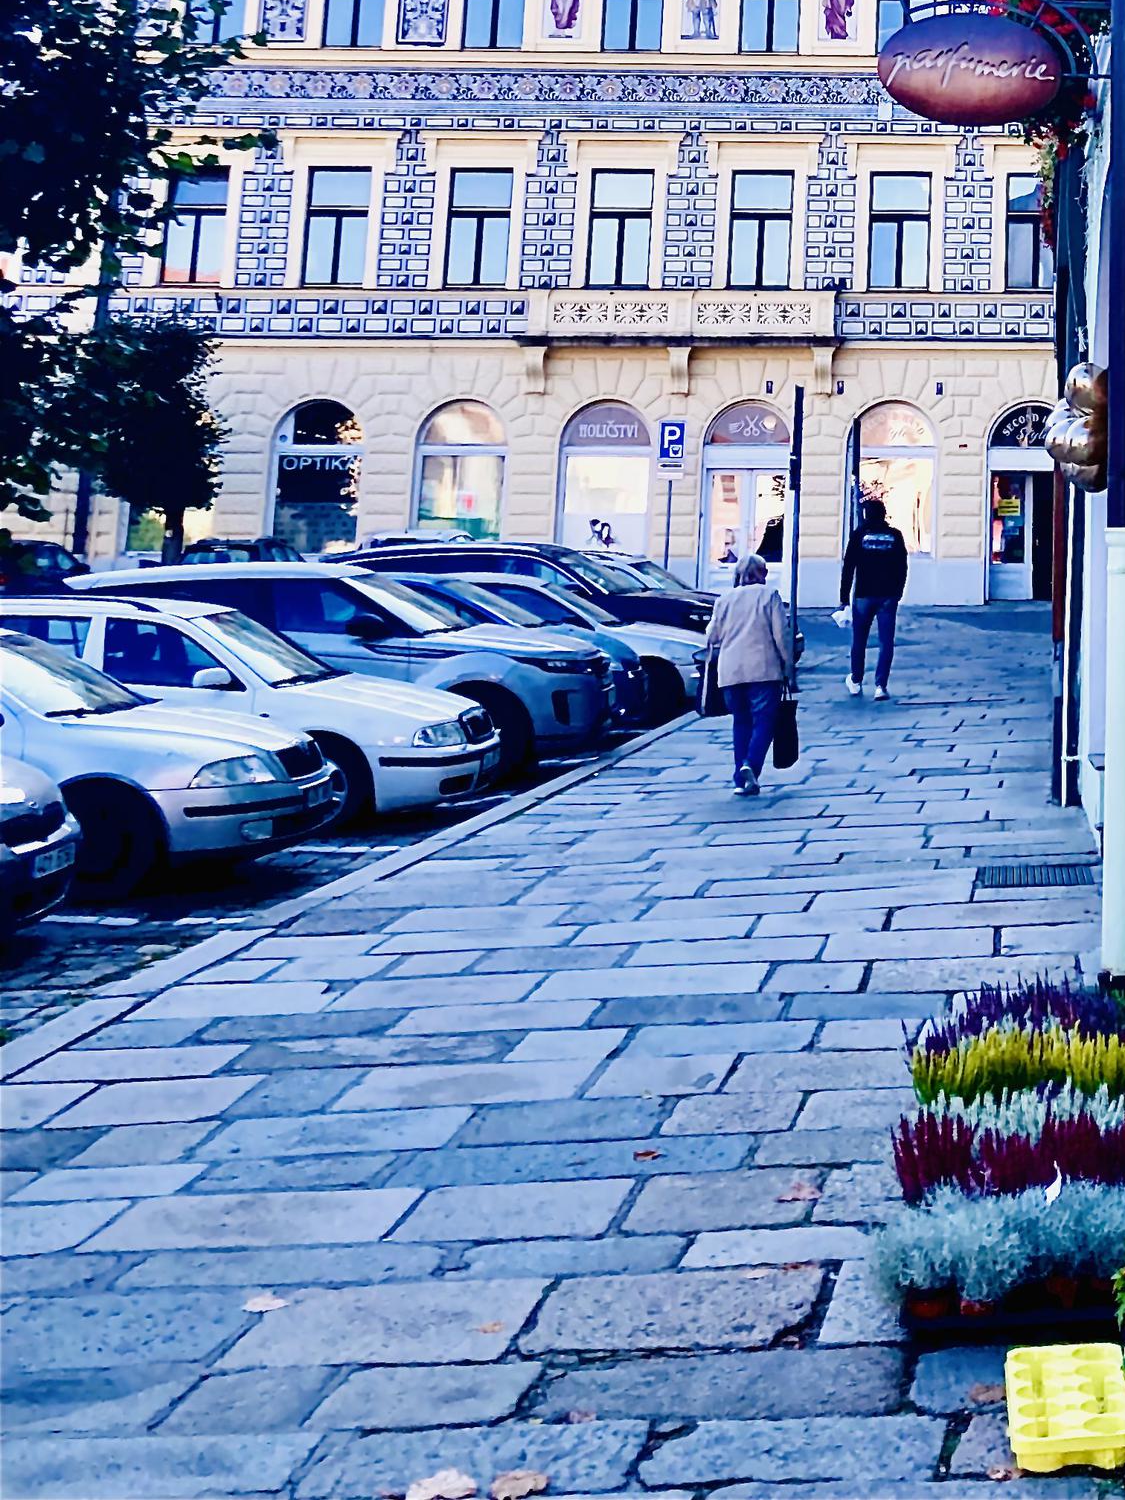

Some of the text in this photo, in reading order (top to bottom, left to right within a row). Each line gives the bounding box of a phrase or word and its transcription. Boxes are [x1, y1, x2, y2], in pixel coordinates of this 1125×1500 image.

[886, 41, 1055, 88] parfumerie
[579, 420, 639, 438] HOLIČSTVÍ
[663, 426, 681, 448] P
